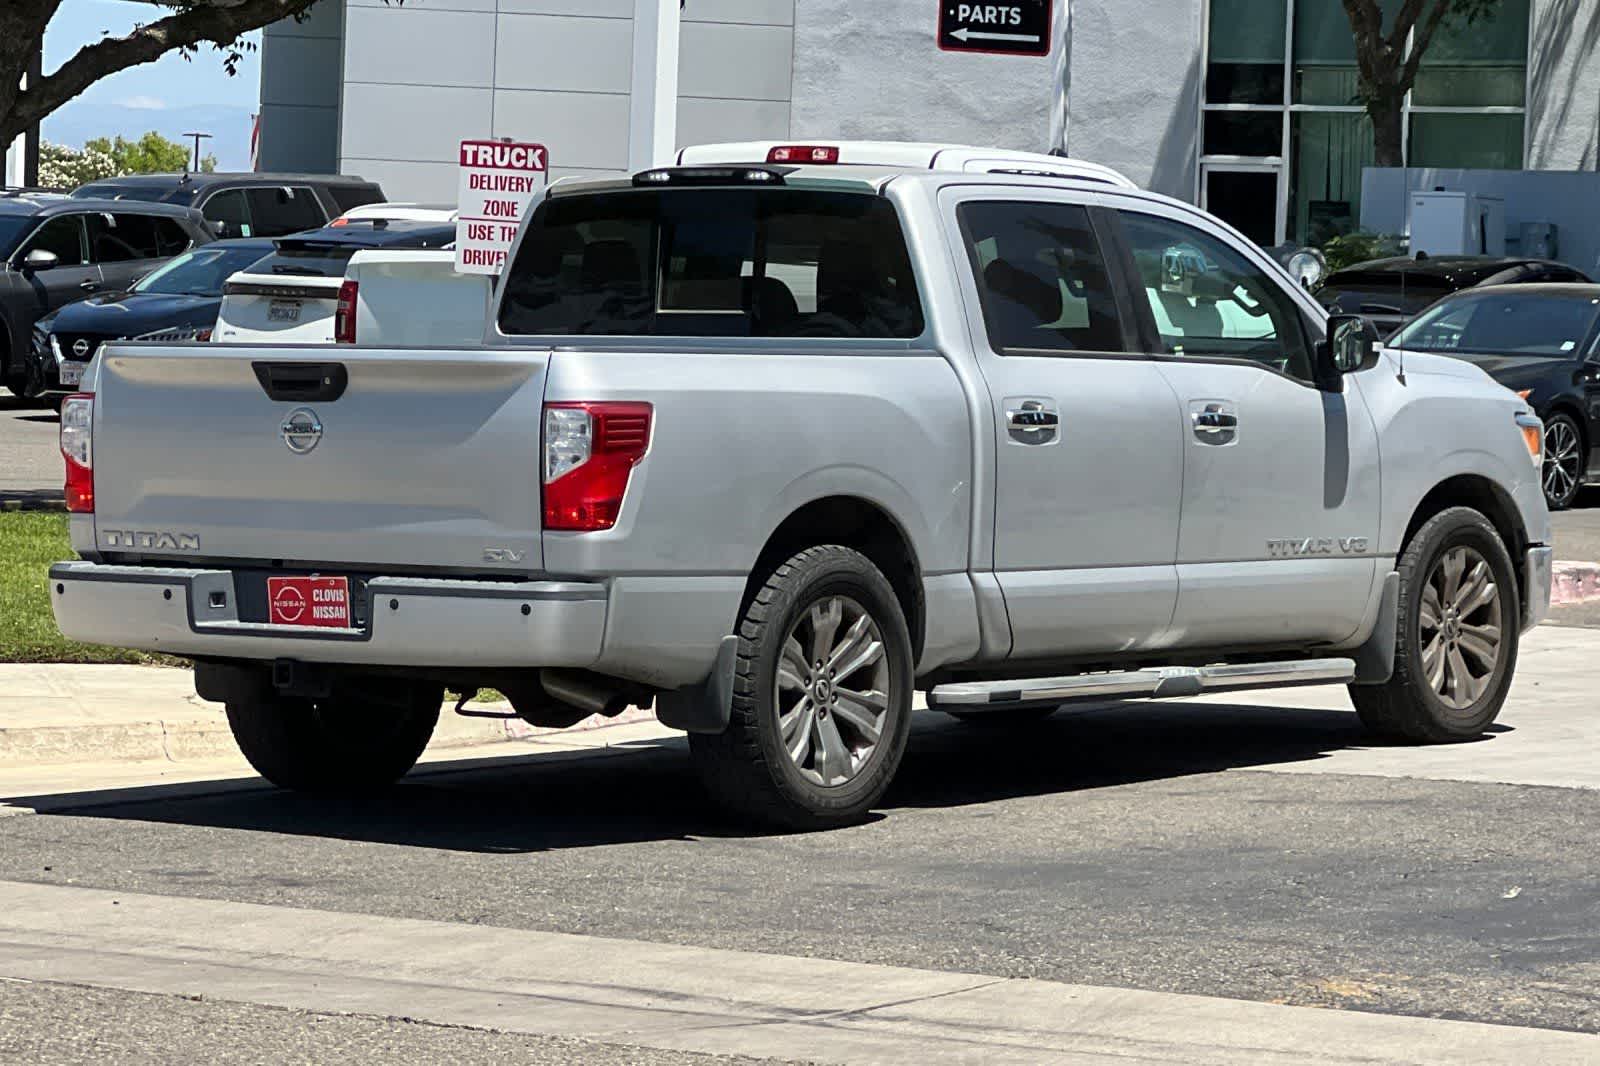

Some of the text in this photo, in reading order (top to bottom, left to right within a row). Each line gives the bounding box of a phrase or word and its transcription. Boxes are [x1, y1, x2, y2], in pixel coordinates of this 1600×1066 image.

[958, 4, 1021, 25] PARTS
[462, 144, 543, 169] TRUCK
[469, 174, 534, 193] DELIVERY
[483, 200, 519, 217] ZONE
[468, 224, 517, 242] USE TH
[463, 248, 508, 266] DRIVE
[102, 529, 200, 551] TITAN
[1265, 536, 1334, 558] TITAN
[274, 600, 306, 608] NISSAN
[312, 588, 345, 602] CLOVIS
[312, 606, 346, 619] NISSAN
